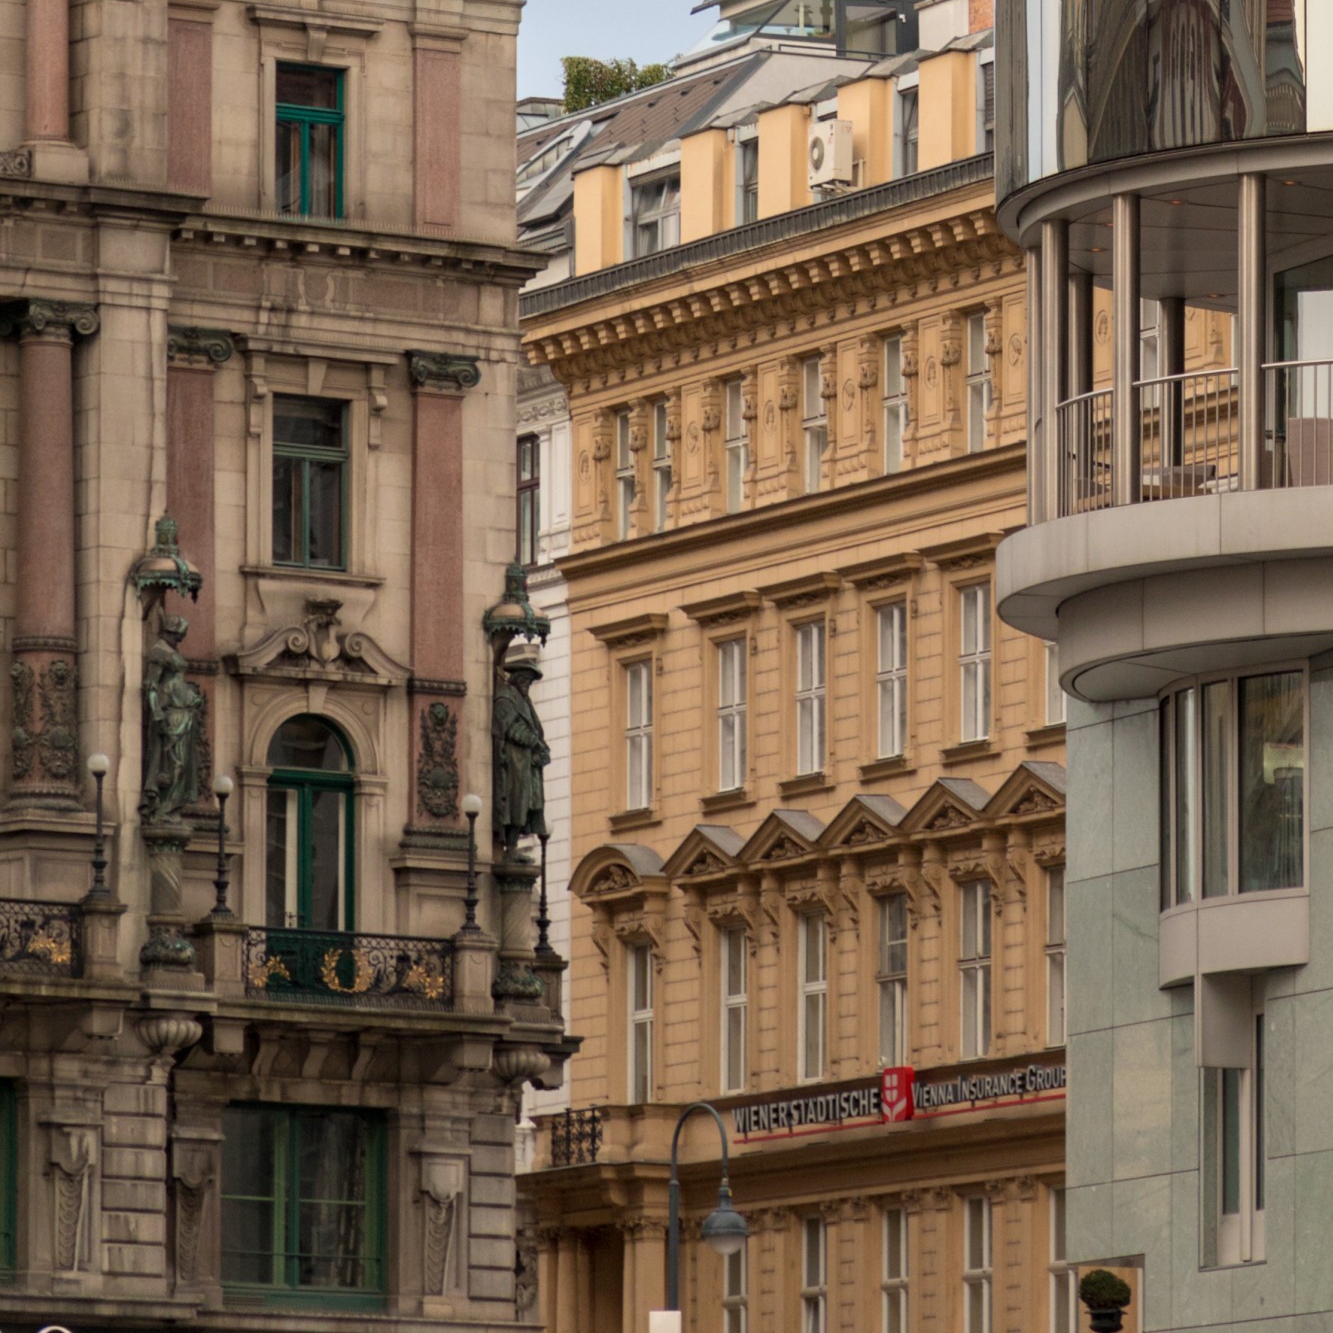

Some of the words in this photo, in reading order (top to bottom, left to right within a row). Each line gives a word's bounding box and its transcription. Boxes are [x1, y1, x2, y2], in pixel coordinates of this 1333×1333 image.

[732, 1101, 788, 1134] WIENER
[789, 1087, 879, 1126] STÄDTISCHE
[911, 1081, 954, 1109] VIENNA
[957, 1073, 1023, 1102] INSURANCE
[1026, 1064, 1067, 1091] GROUP
